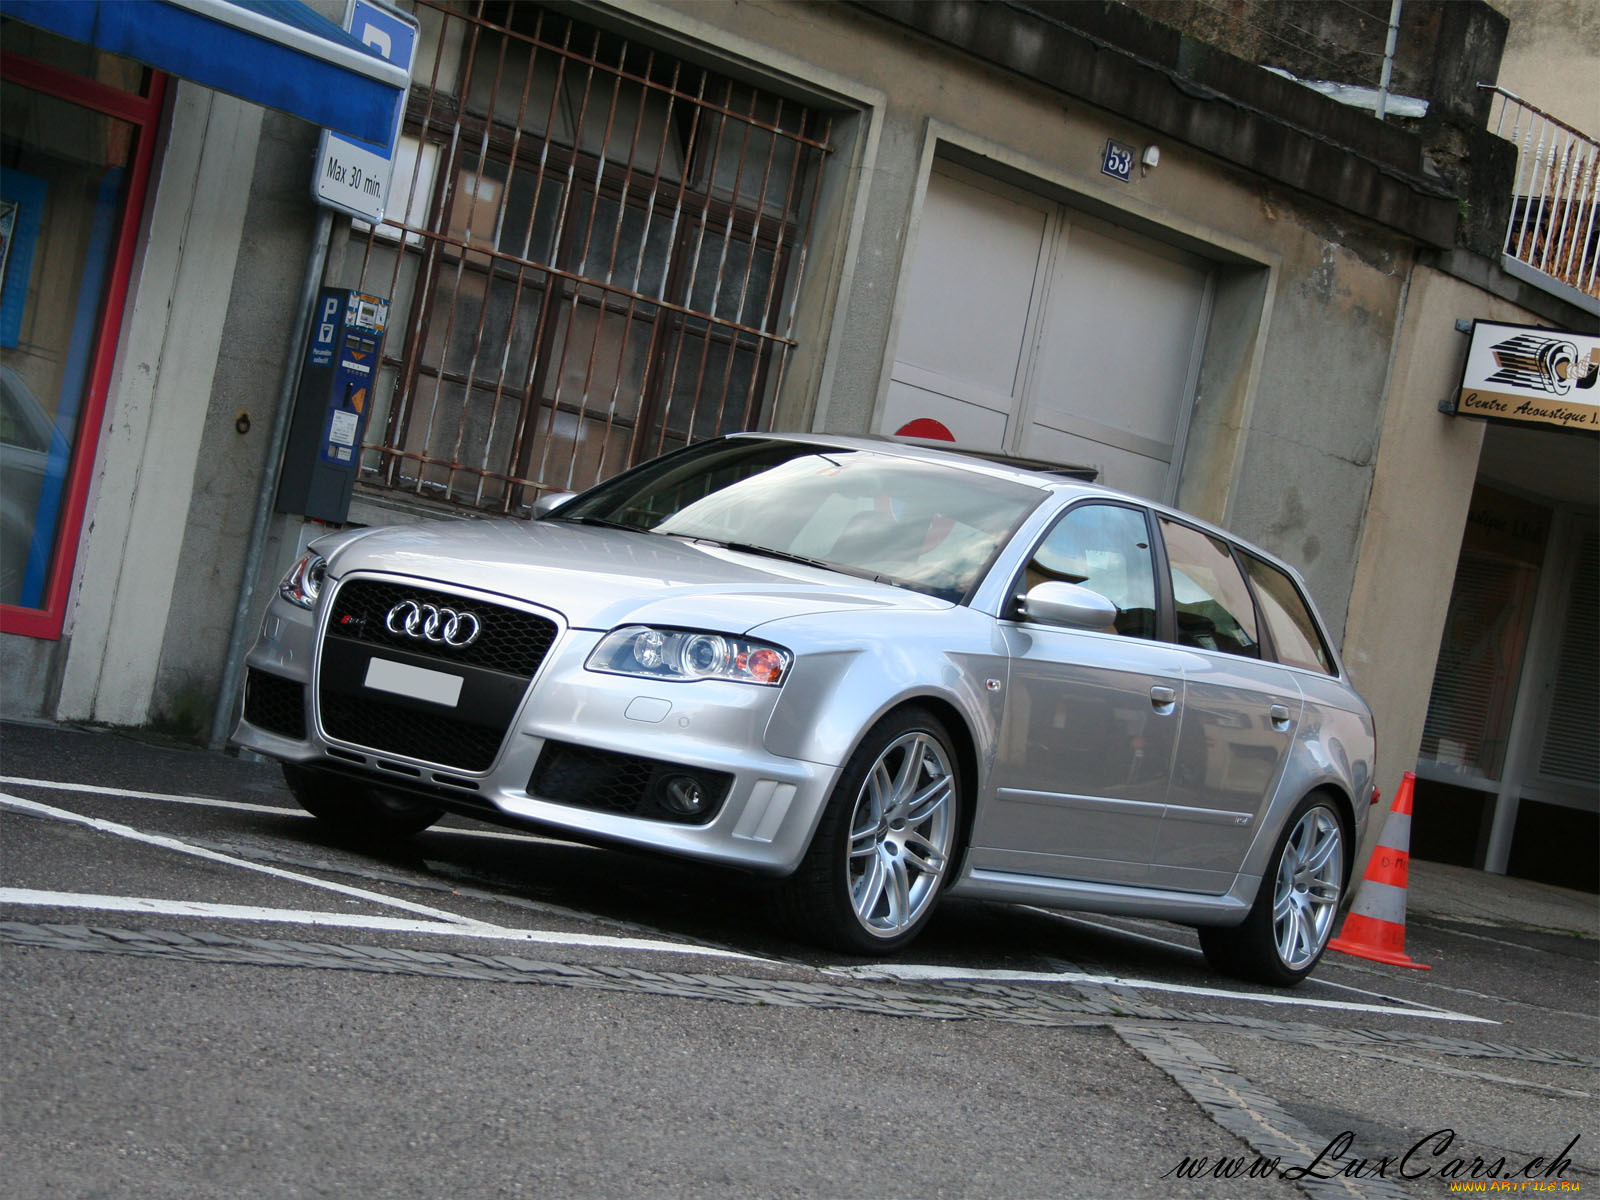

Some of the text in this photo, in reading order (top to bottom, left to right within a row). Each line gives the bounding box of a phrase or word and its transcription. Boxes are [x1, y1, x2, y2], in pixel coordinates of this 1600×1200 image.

[1108, 146, 1131, 175] 53
[326, 156, 381, 199] Max 30 min.
[322, 297, 338, 323] P
[1465, 393, 1508, 412] Centre
[1513, 400, 1587, 425] Acoustique
